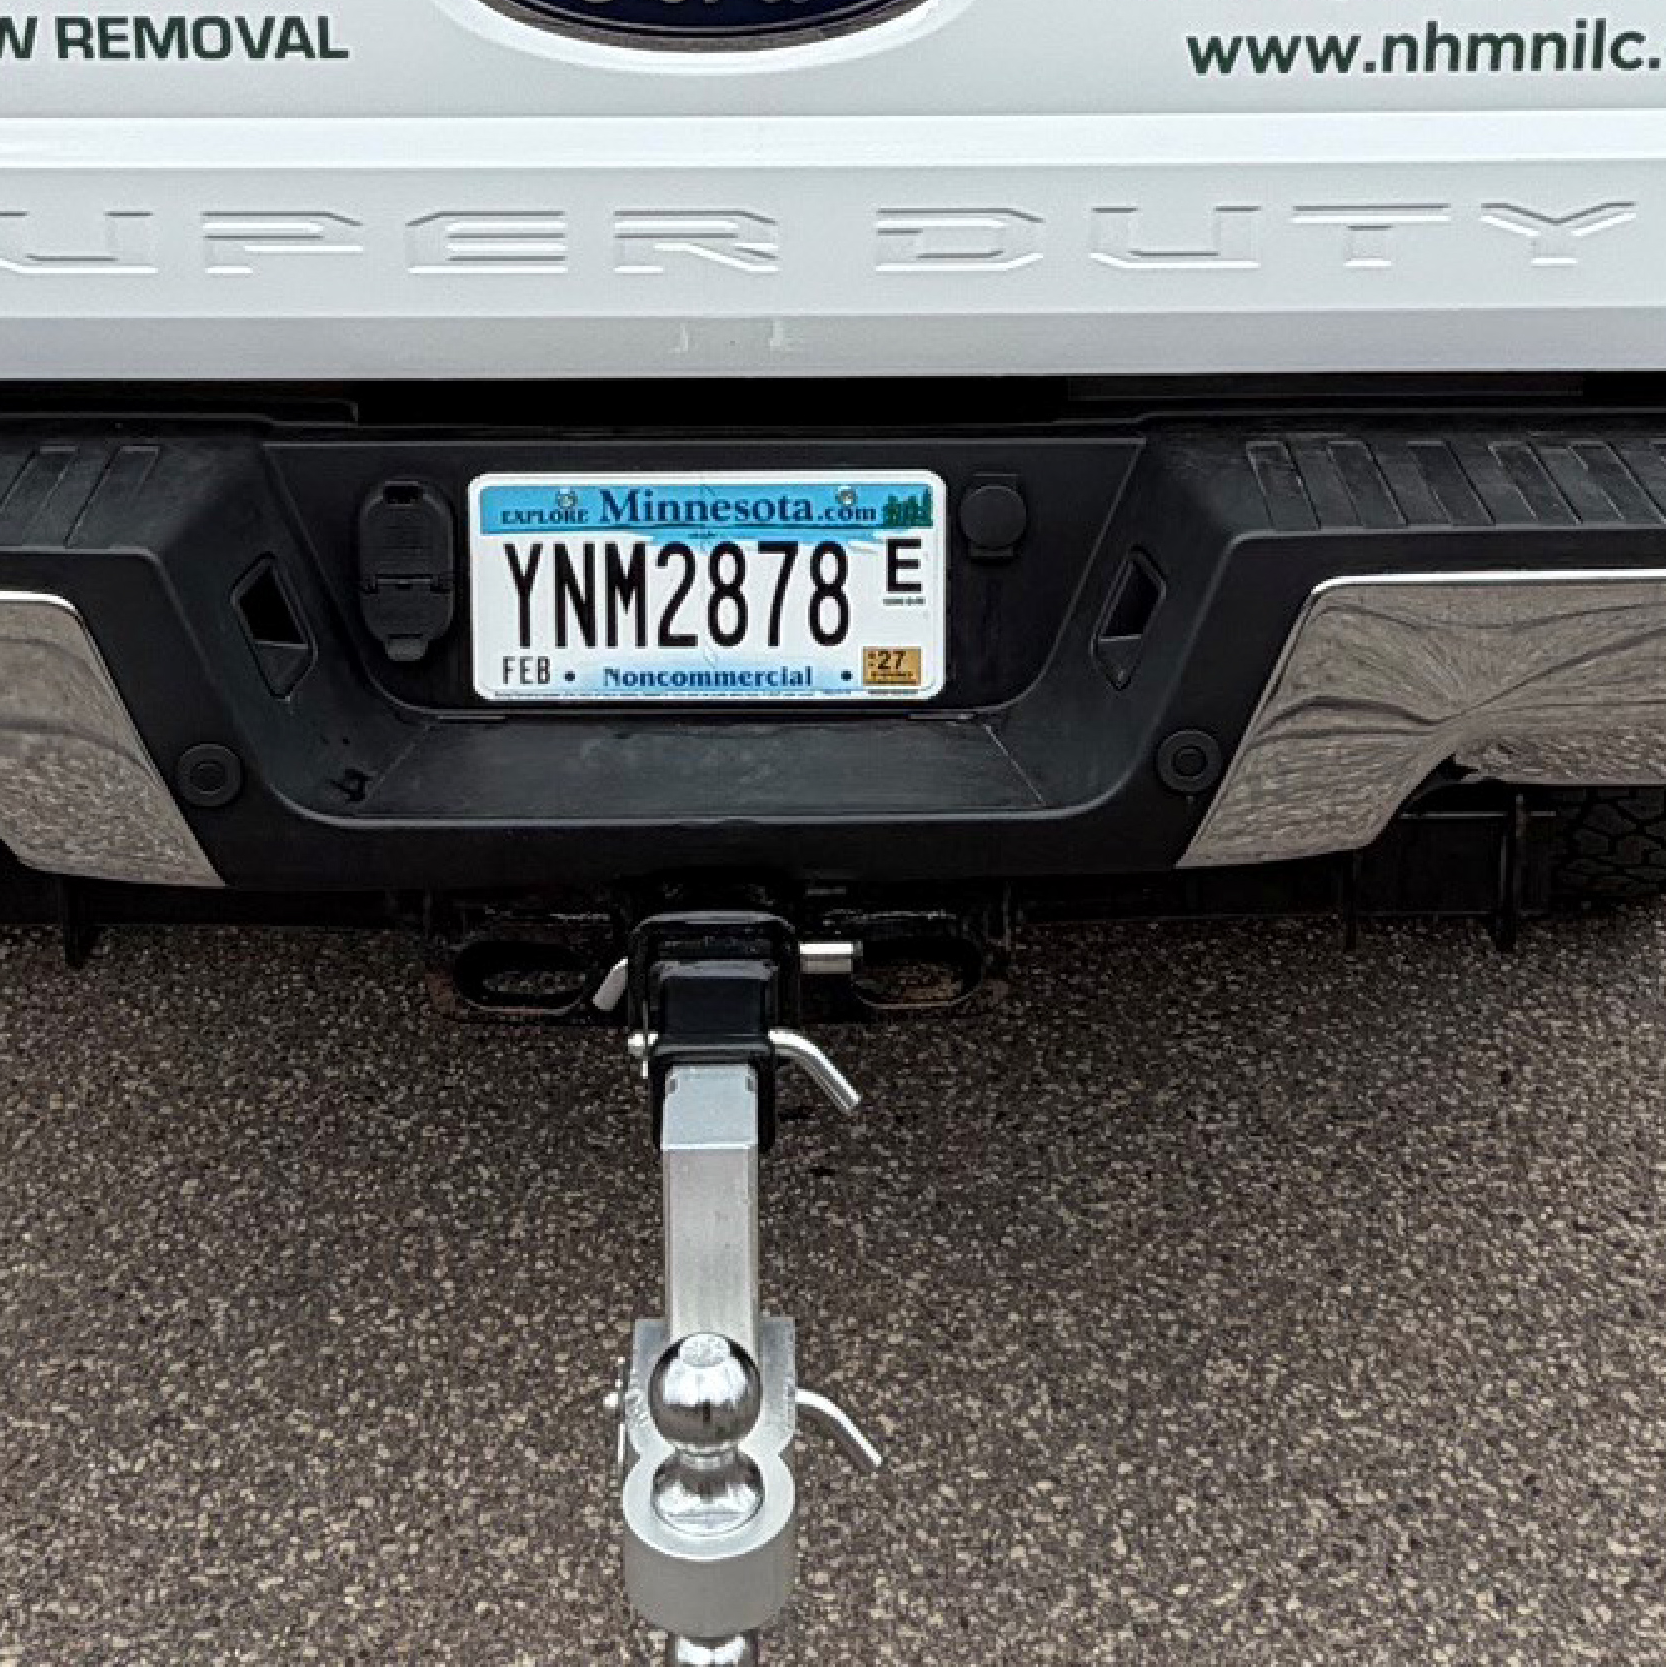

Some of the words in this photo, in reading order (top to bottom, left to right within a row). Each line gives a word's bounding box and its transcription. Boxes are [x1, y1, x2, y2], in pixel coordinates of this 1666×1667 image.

[55, 16, 349, 60] REMOVAL
[875, 201, 1637, 272] DUTY
[885, 538, 922, 592] E
[504, 540, 851, 649] YNM2878
[502, 655, 551, 685] FEB
[602, 665, 813, 687] Noncommercial
[876, 649, 907, 670] 27
